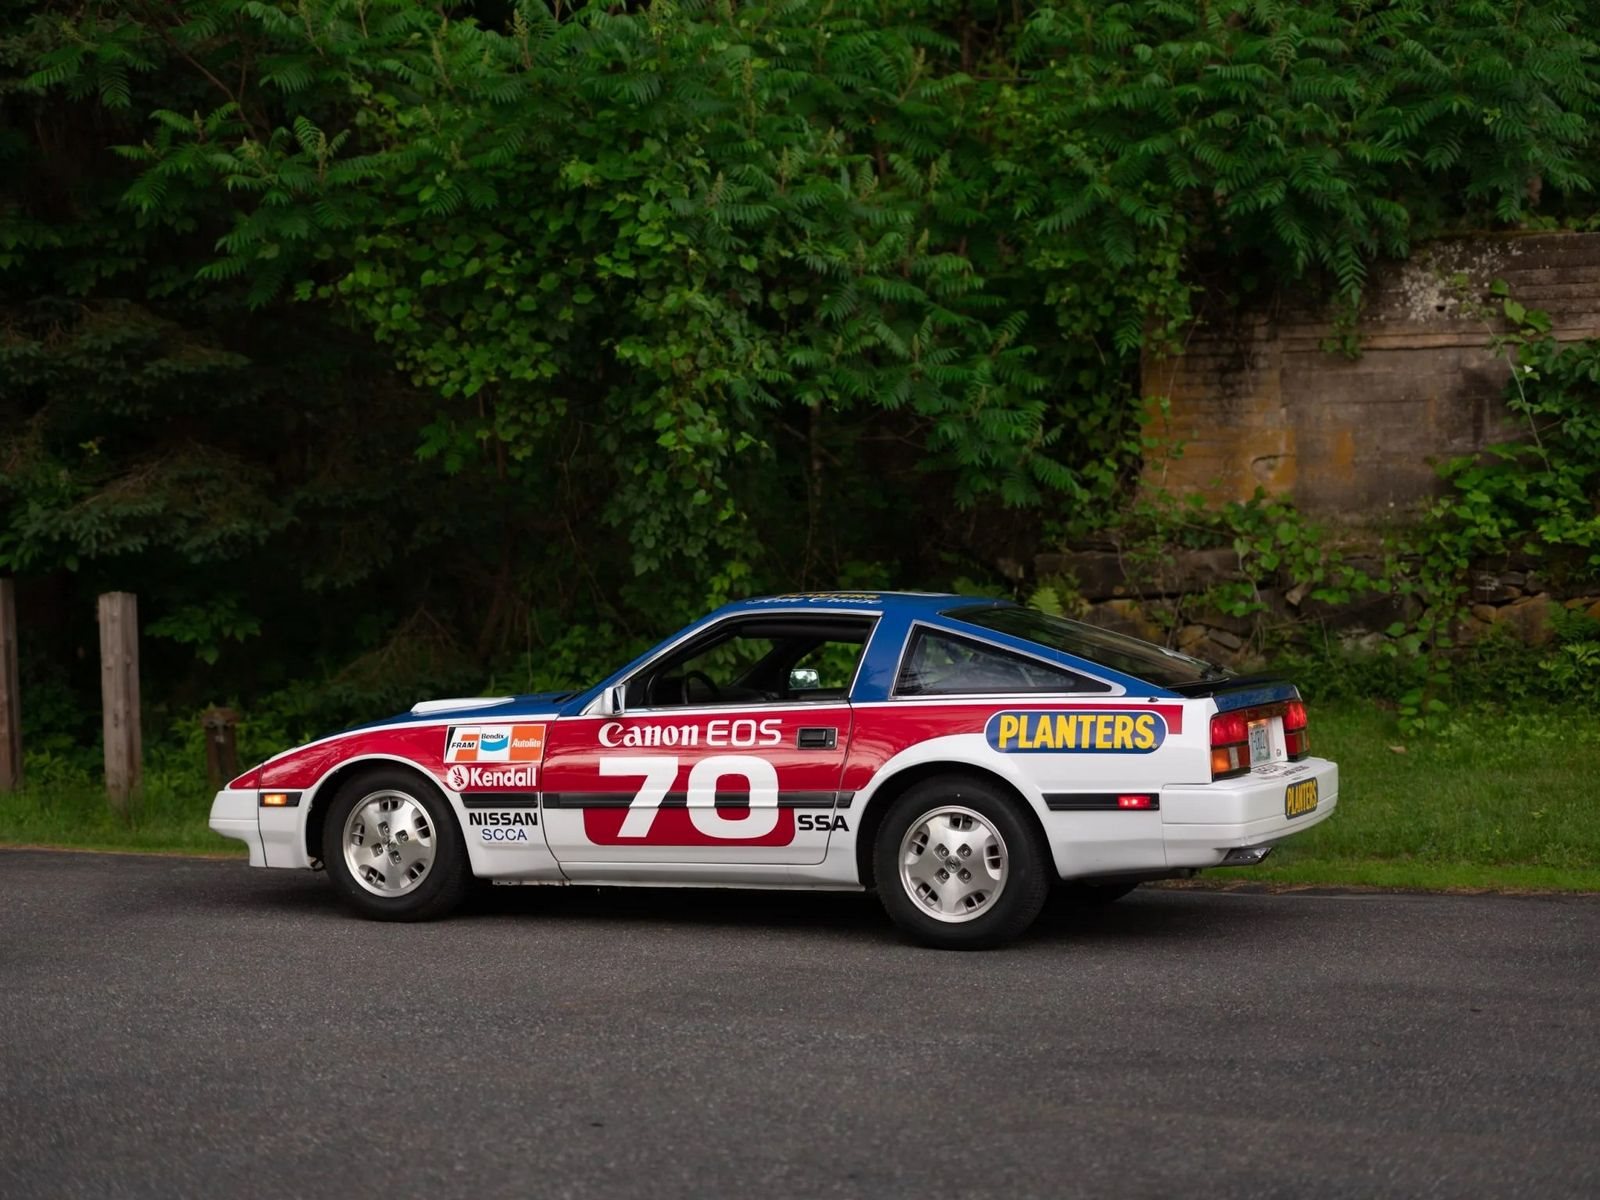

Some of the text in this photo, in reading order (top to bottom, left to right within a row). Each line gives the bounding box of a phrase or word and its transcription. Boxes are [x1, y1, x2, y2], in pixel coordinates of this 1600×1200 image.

[598, 719, 783, 747] Canon EOS
[998, 714, 1156, 749] PLANTERS
[511, 738, 541, 748] Autolite
[470, 767, 537, 787] Kendall
[599, 754, 779, 839] 70
[1286, 779, 1317, 816] PLANTERS
[469, 812, 538, 826] NISSAN
[797, 814, 850, 832] SSA
[482, 828, 528, 841] SCCA
